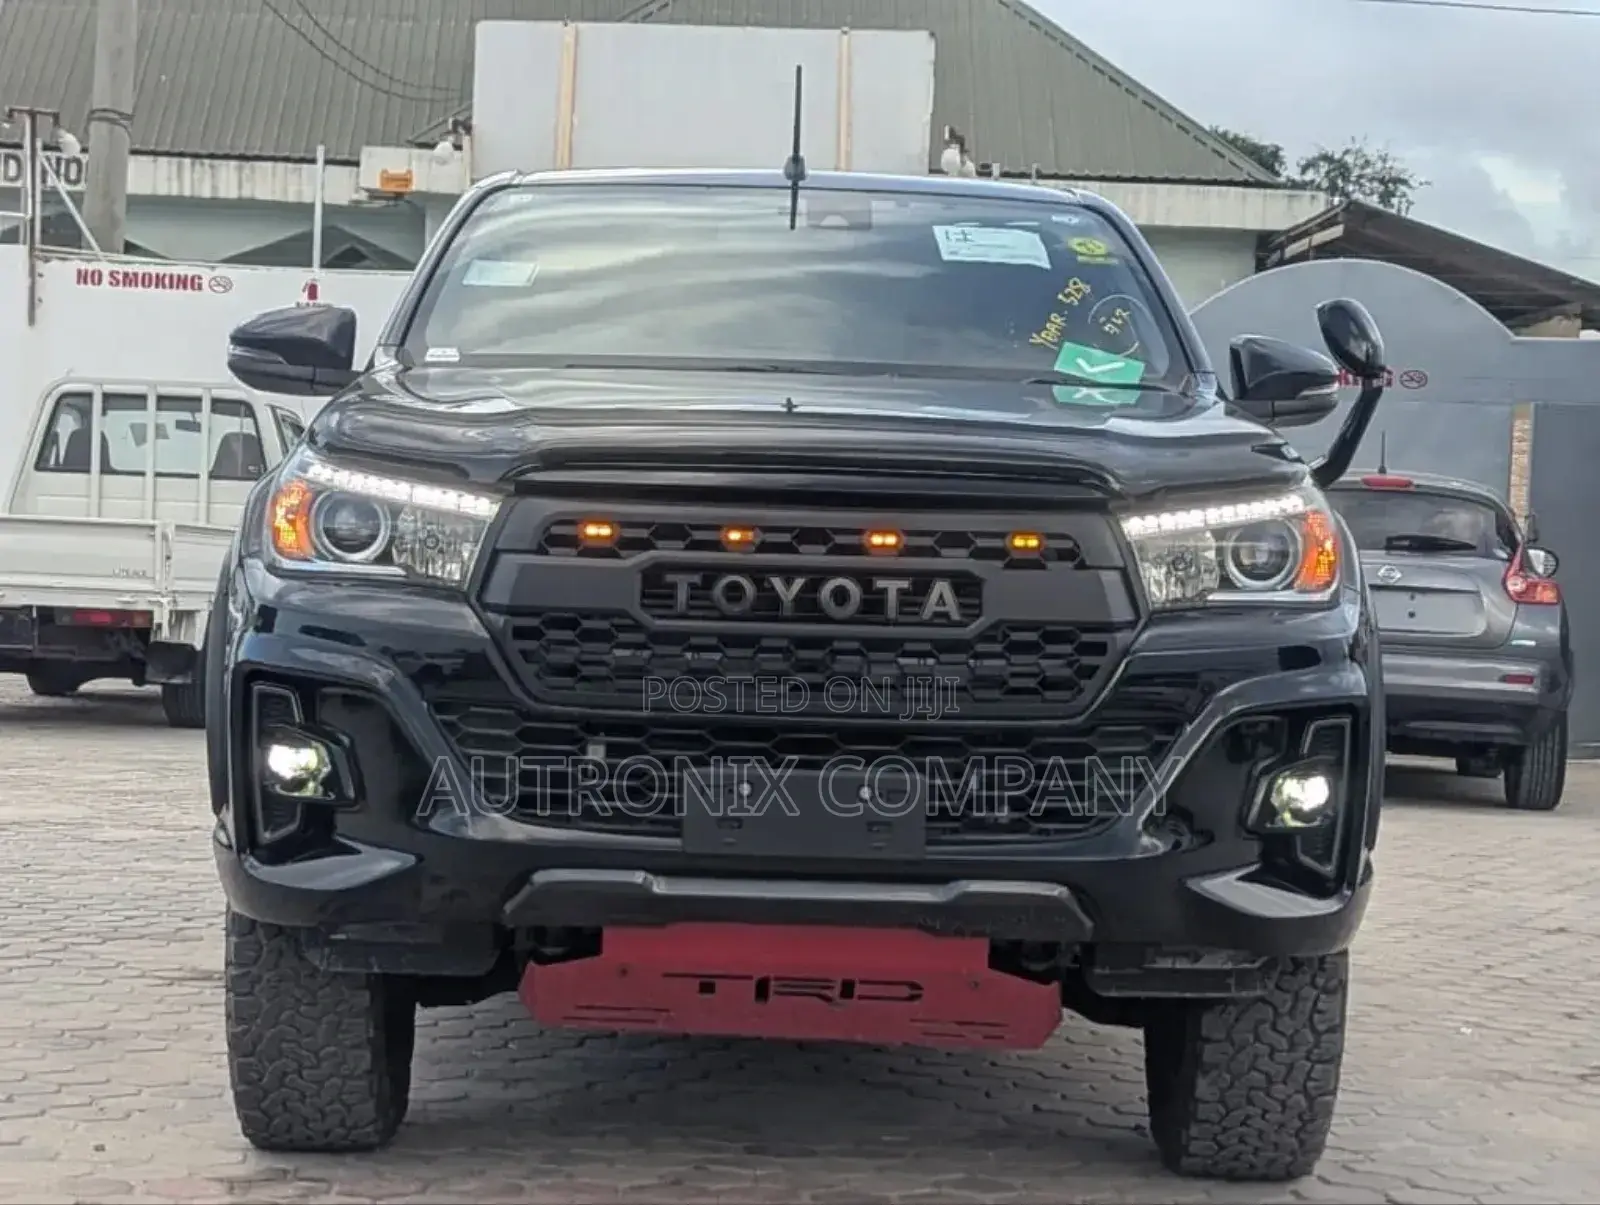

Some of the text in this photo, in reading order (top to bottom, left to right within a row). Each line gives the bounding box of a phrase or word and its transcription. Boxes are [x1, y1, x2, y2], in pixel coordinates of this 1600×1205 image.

[76, 268, 203, 291] NO SMOKING
[664, 574, 962, 621] TOYOTA
[662, 972, 925, 1005] TRD
